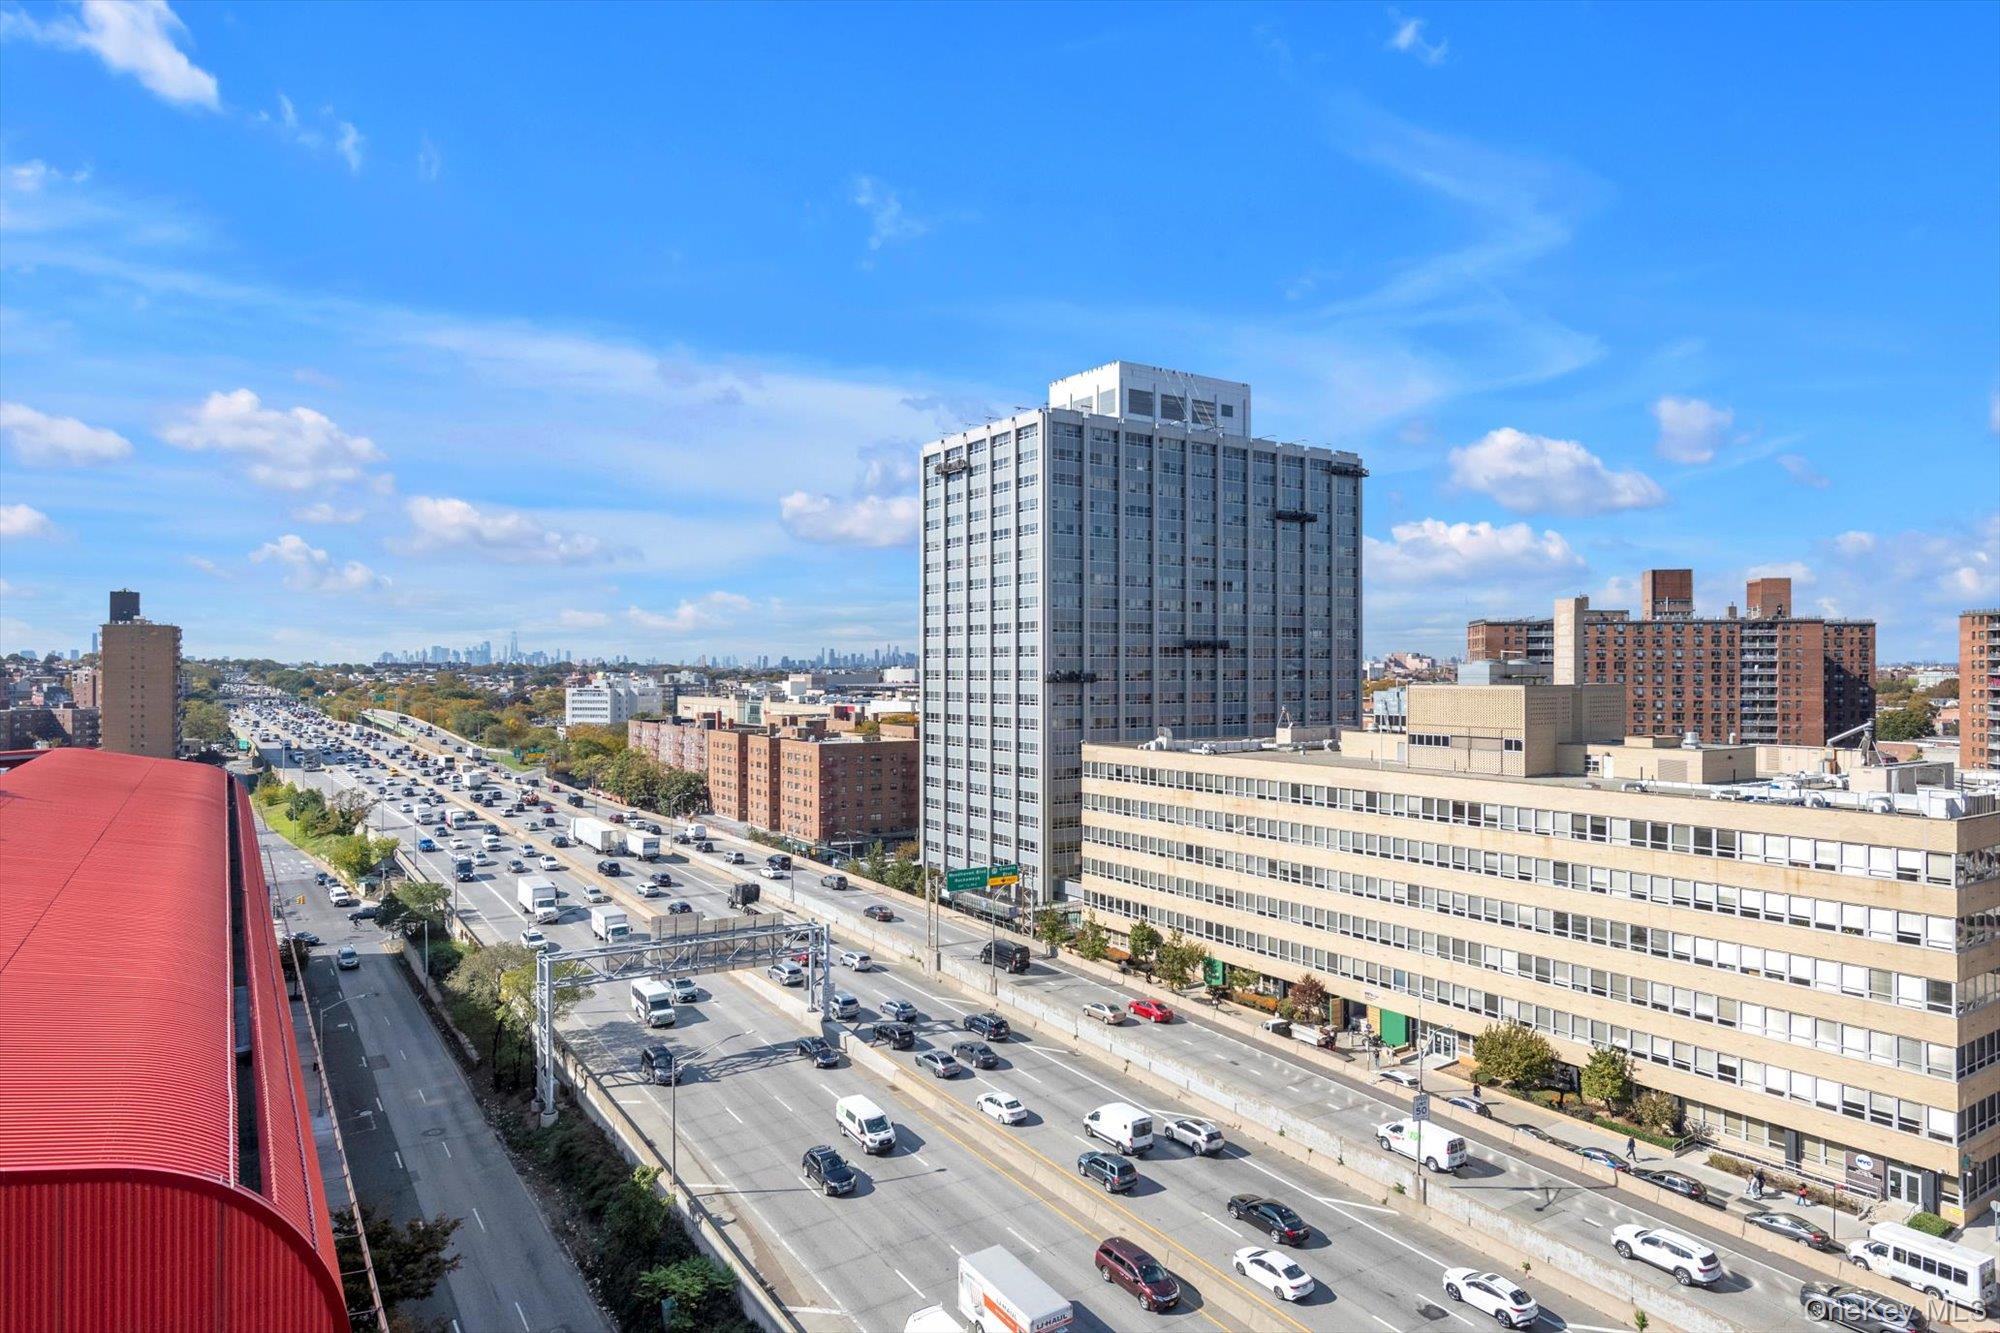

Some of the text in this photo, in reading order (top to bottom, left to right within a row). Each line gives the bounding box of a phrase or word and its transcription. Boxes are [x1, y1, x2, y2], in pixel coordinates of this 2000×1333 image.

[1416, 1106, 1427, 1115] 50
[1857, 1158, 1872, 1167] NYC
[1036, 1314, 1068, 1330] U-HAUL
